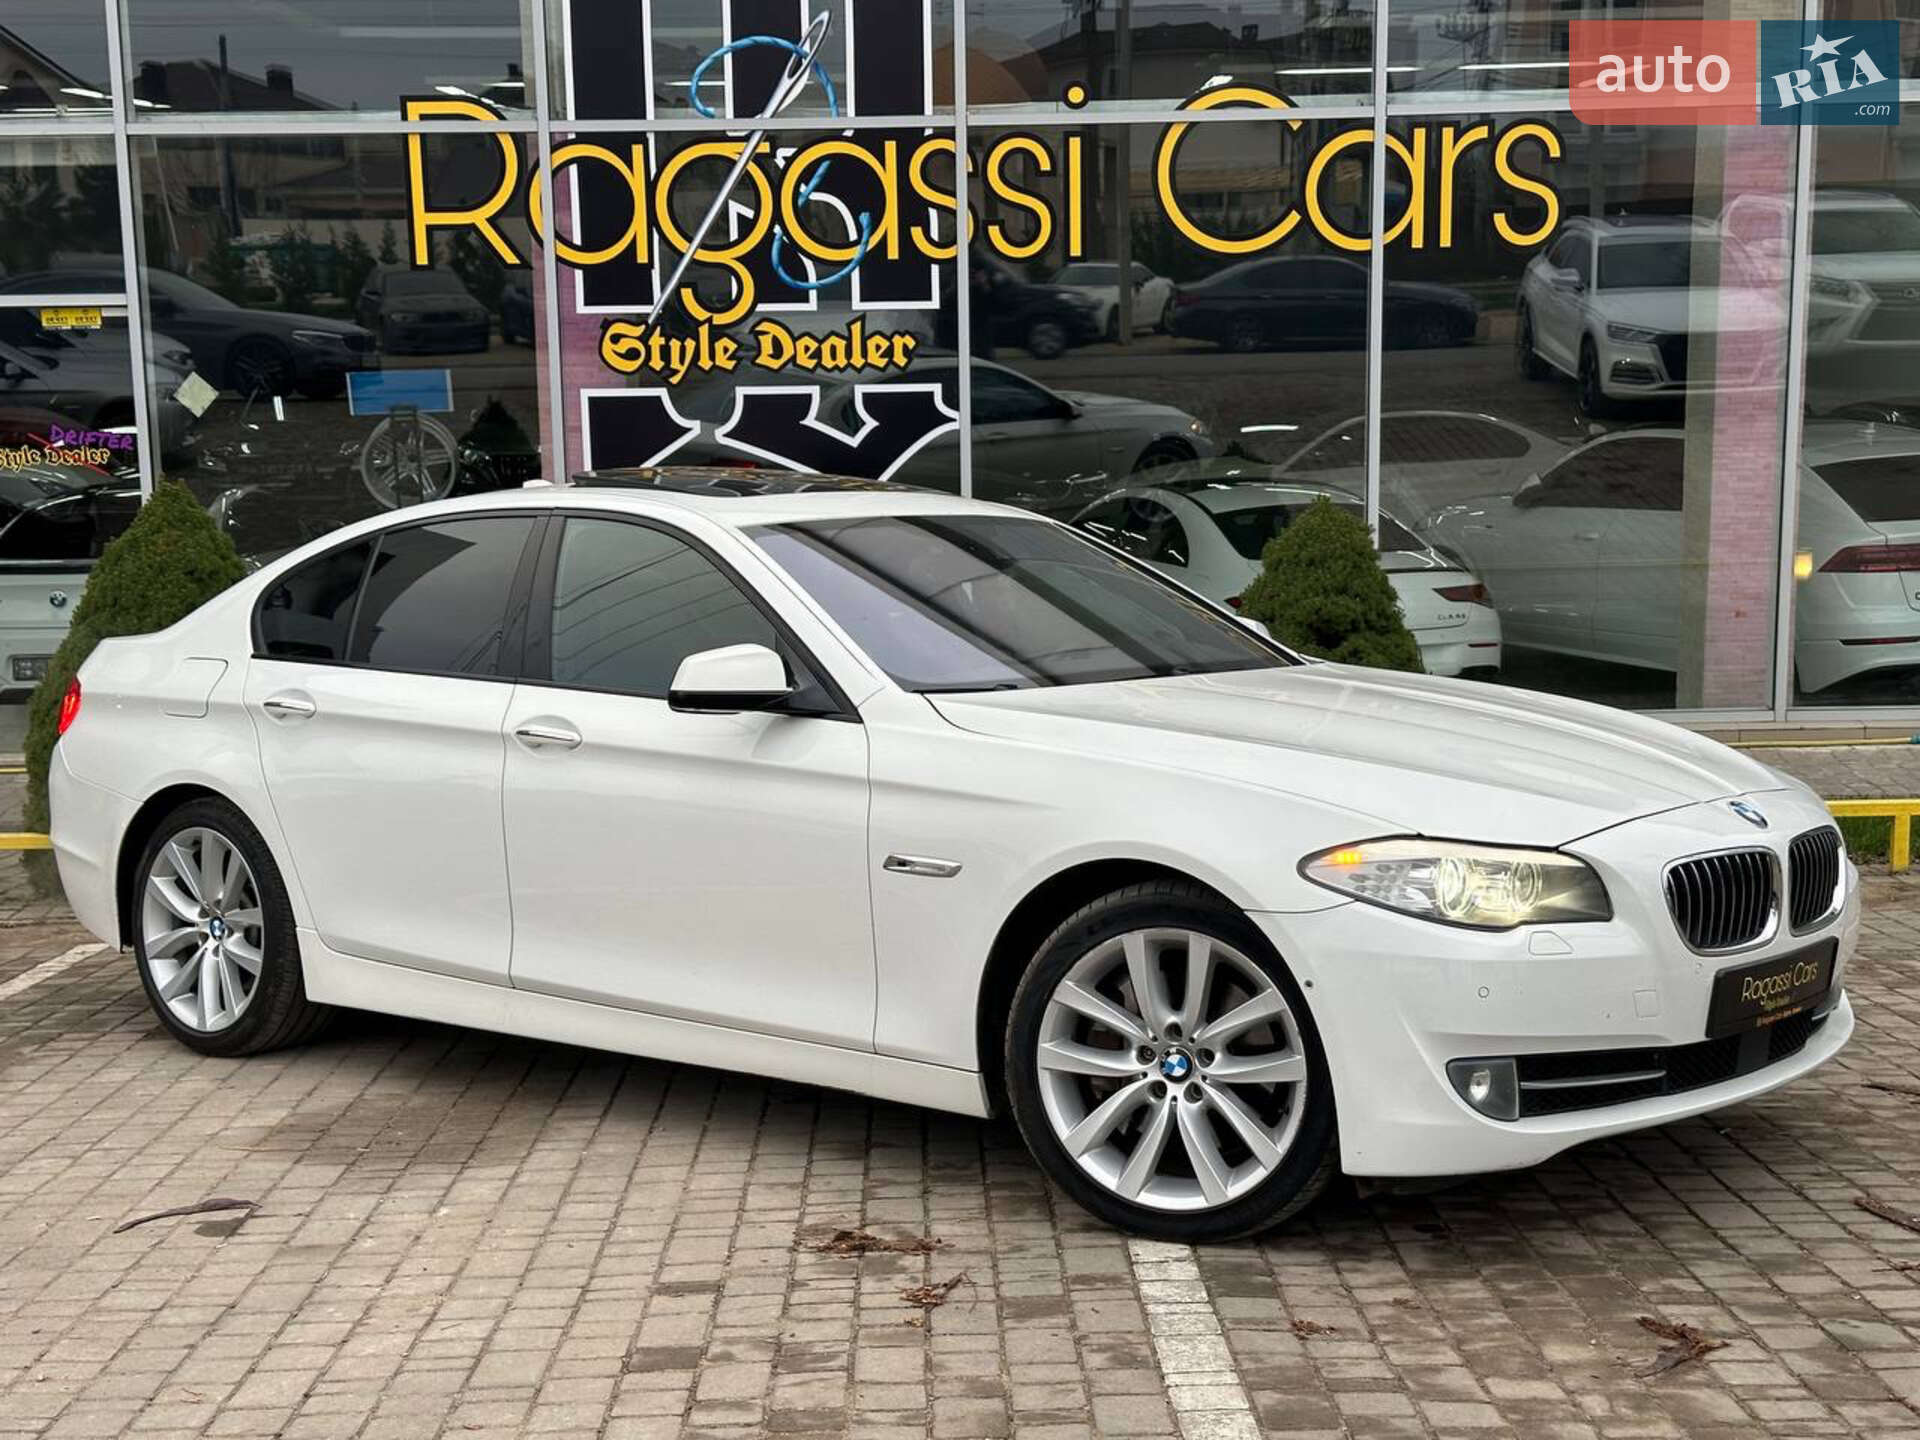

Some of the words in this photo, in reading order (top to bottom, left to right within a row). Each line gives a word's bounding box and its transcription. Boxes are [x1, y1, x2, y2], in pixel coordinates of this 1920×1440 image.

[404, 86, 1085, 327] Ragassi
[1155, 87, 1564, 255] Cars
[601, 321, 739, 384] Style
[754, 319, 917, 371] Dealer
[44, 444, 111, 467] Dealer
[50, 423, 135, 451] DRIFTER
[1740, 964, 1793, 1006] Ragassi
